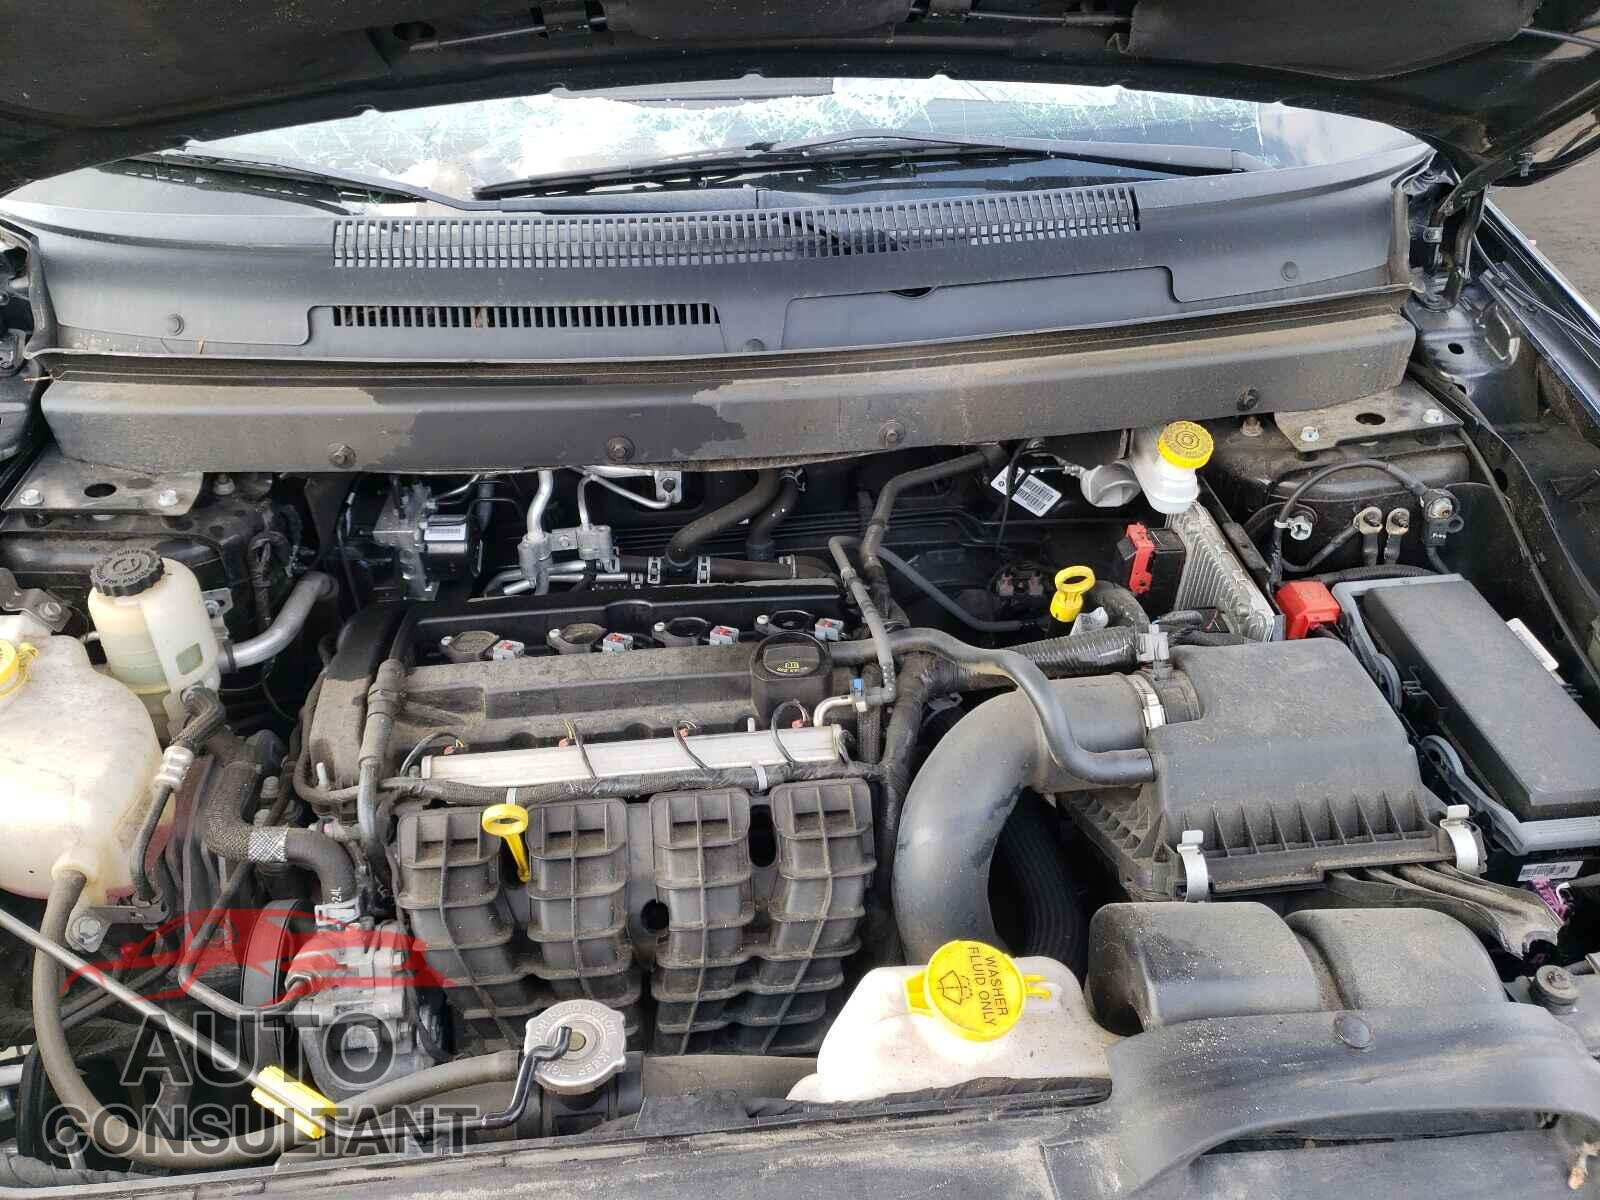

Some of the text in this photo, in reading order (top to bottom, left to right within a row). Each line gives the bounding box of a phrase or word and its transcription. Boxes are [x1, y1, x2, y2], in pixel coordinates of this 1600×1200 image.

[968, 947, 997, 1026] FLUID ONLY
[985, 956, 1009, 1016] WASHER
